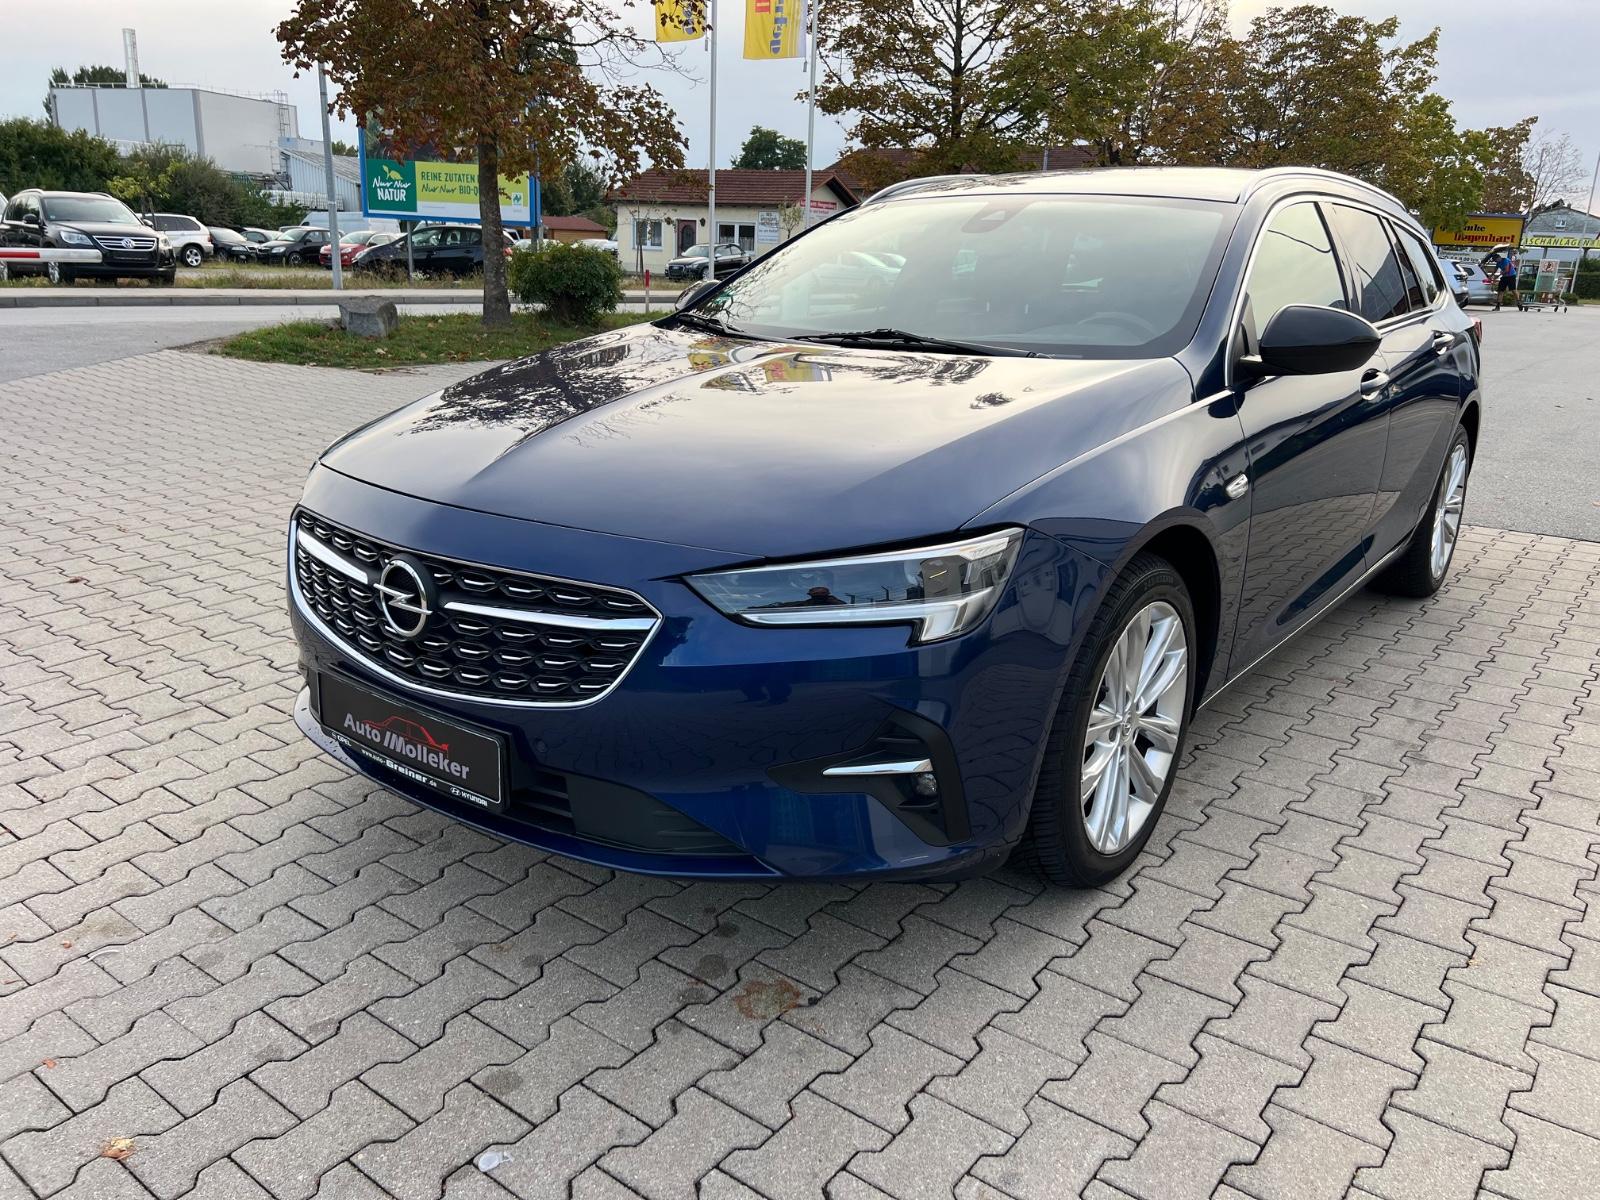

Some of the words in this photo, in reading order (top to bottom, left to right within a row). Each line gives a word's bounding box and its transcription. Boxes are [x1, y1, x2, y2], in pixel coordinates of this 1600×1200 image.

[372, 175, 393, 188] Nur
[393, 180, 412, 189] Nur
[421, 171, 442, 182] REINE
[444, 172, 476, 183] ZUTATEN
[377, 187, 406, 202] NATUR
[421, 183, 439, 193] Nur
[440, 184, 457, 194] Nur
[459, 185, 479, 197] BIO-Q
[343, 712, 381, 743] Auto
[337, 734, 352, 747] OPEL
[461, 791, 488, 807] HYUNDAI
